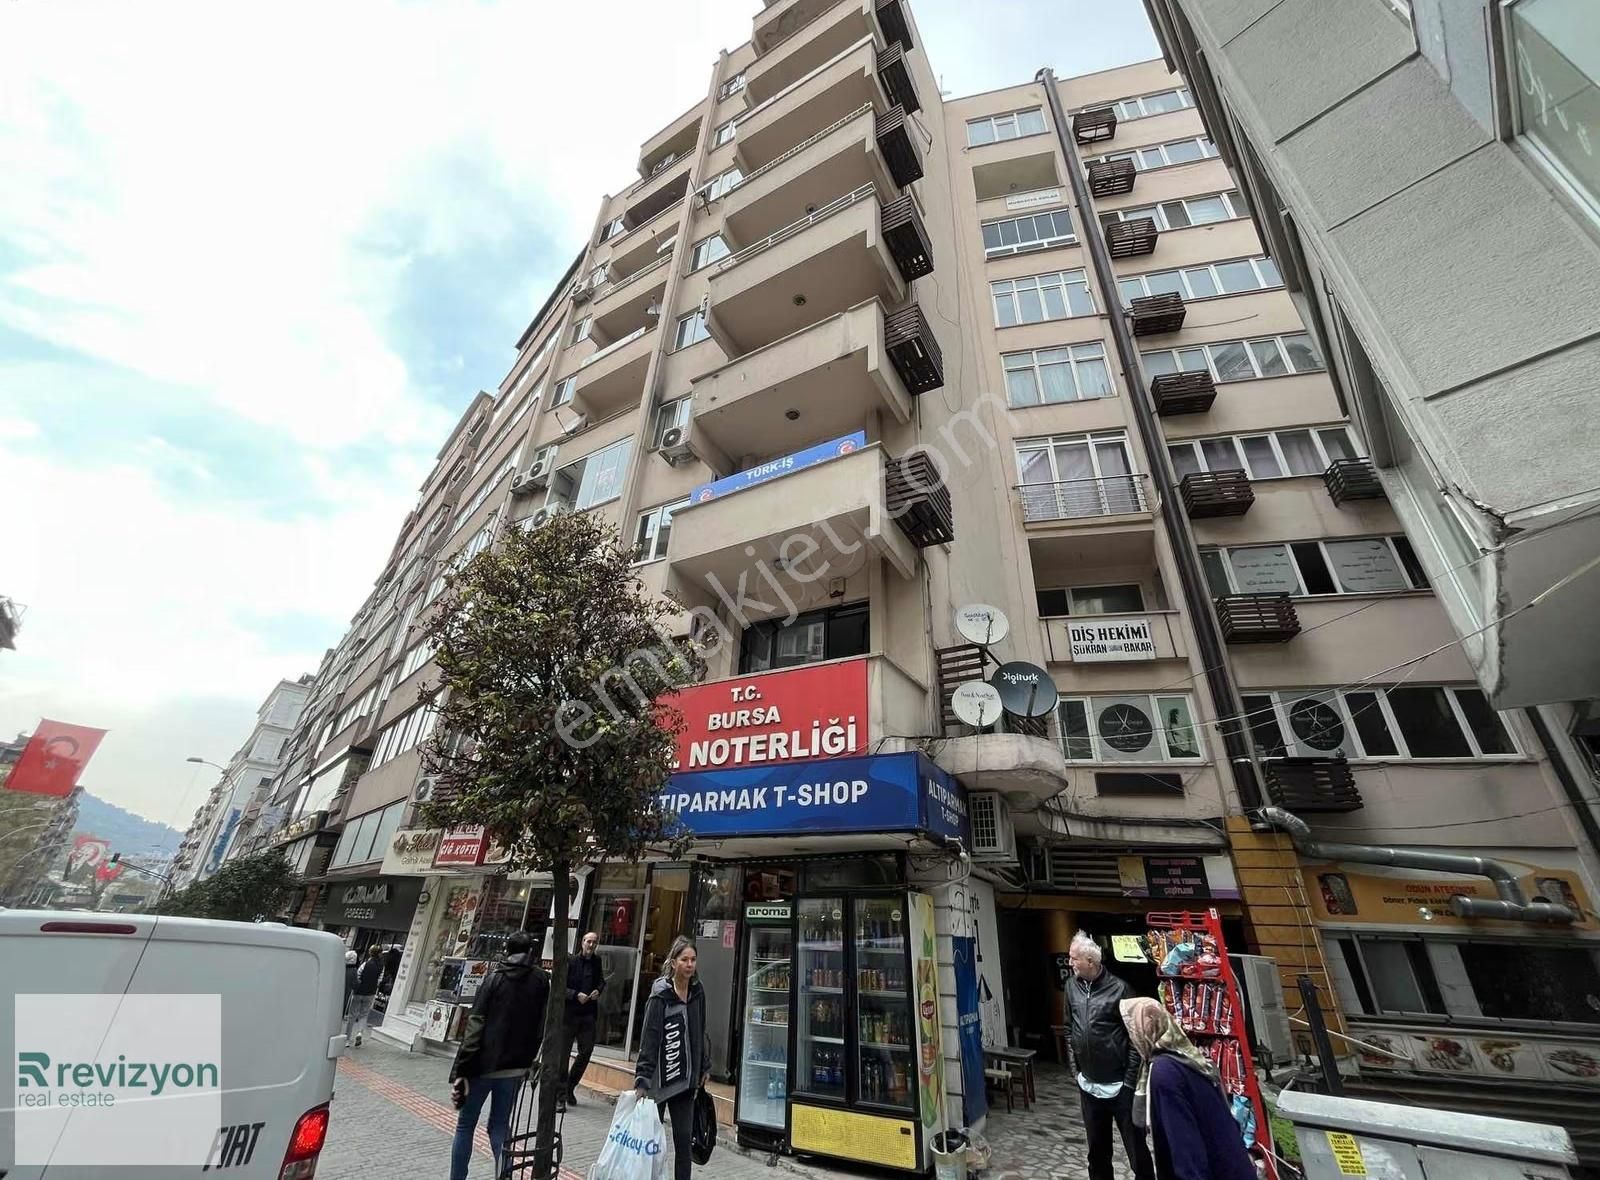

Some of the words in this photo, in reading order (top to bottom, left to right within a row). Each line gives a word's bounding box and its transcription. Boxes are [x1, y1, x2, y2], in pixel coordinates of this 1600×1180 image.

[746, 456, 794, 480] TÜRK-İŞ
[1071, 625, 1095, 644] DİŞ
[1097, 623, 1149, 641] HEKİMİ
[1123, 641, 1153, 653] BAKAR
[730, 685, 762, 702] T.C.
[708, 705, 781, 731] BURSA
[689, 715, 858, 768] NOTERLİĞİ
[642, 786, 768, 816] TIPARMAK
[773, 780, 869, 808] T-SHOP
[748, 906, 789, 917] aroma
[202, 1121, 266, 1172] FIAT
